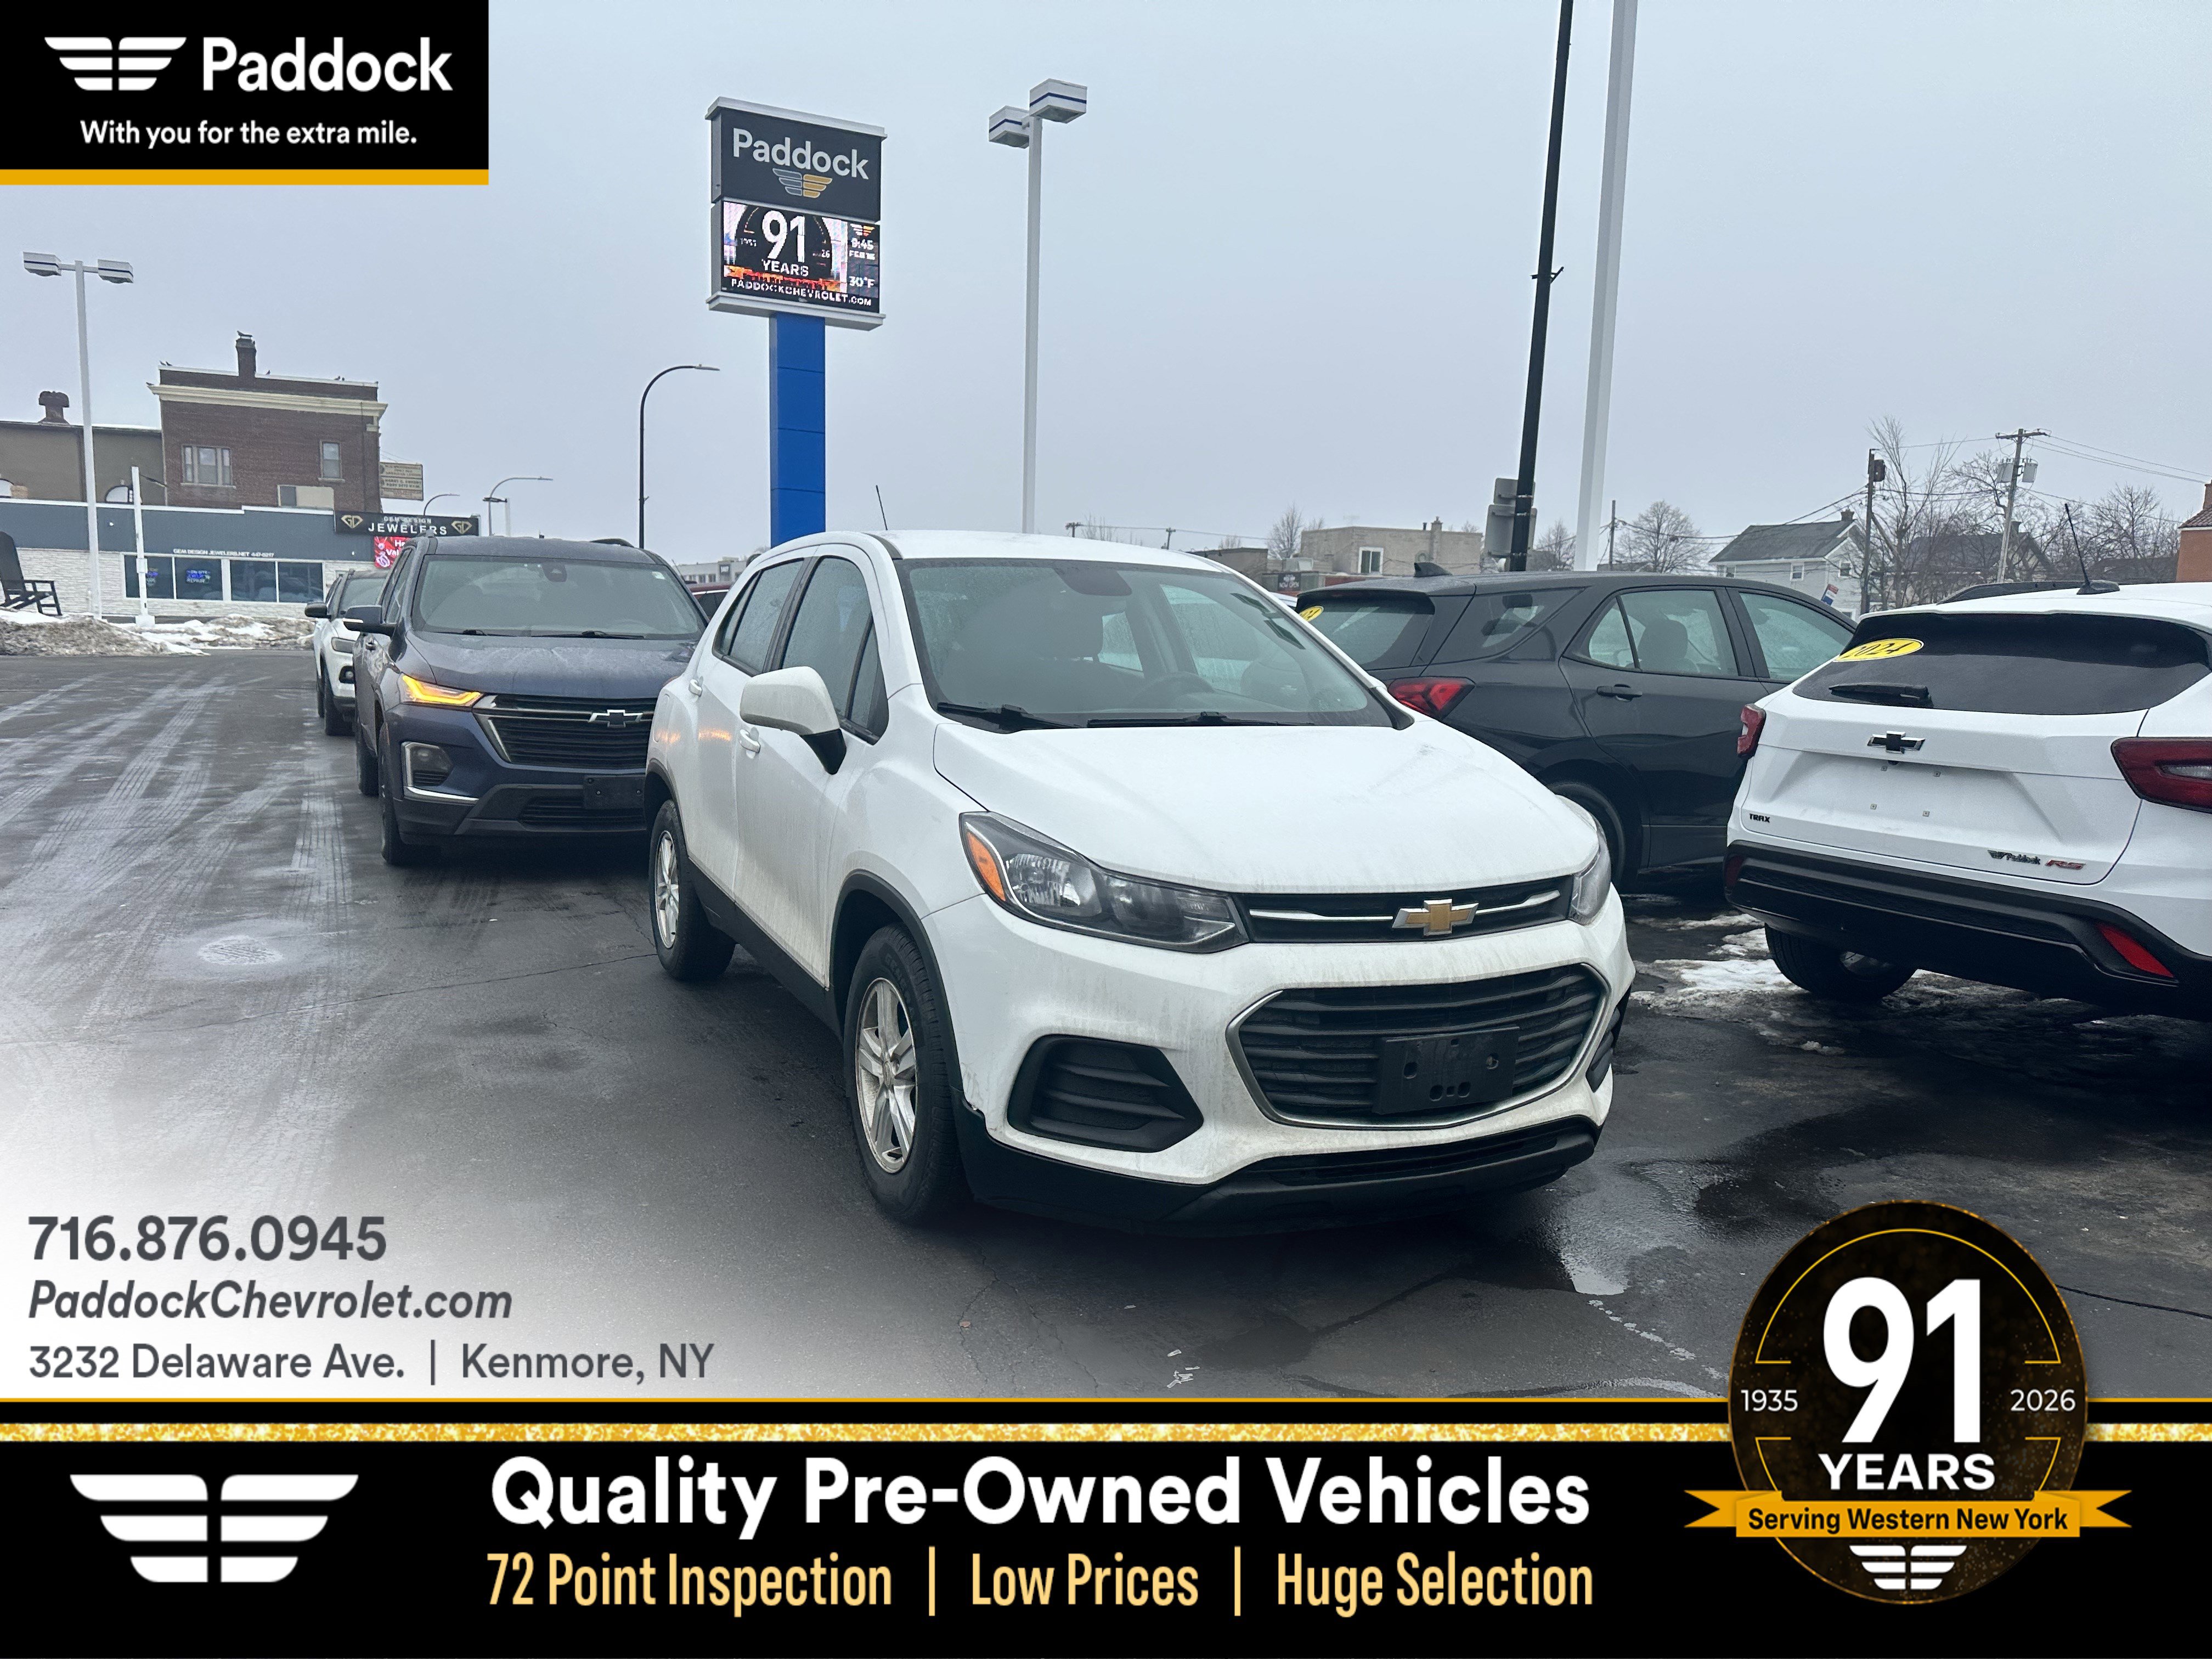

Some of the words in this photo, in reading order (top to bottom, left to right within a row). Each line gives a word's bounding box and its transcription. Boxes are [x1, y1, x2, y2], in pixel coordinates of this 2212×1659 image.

[733, 127, 869, 180] Paddock
[762, 210, 805, 263] 91
[761, 258, 809, 277] YEARS
[731, 278, 872, 307] PADDOCKCHEVROLET.COM
[368, 522, 447, 535] JEWELERS
[1841, 641, 1915, 659] 2024
[1750, 813, 1770, 823] TRAX
[2045, 859, 2086, 870] RS
